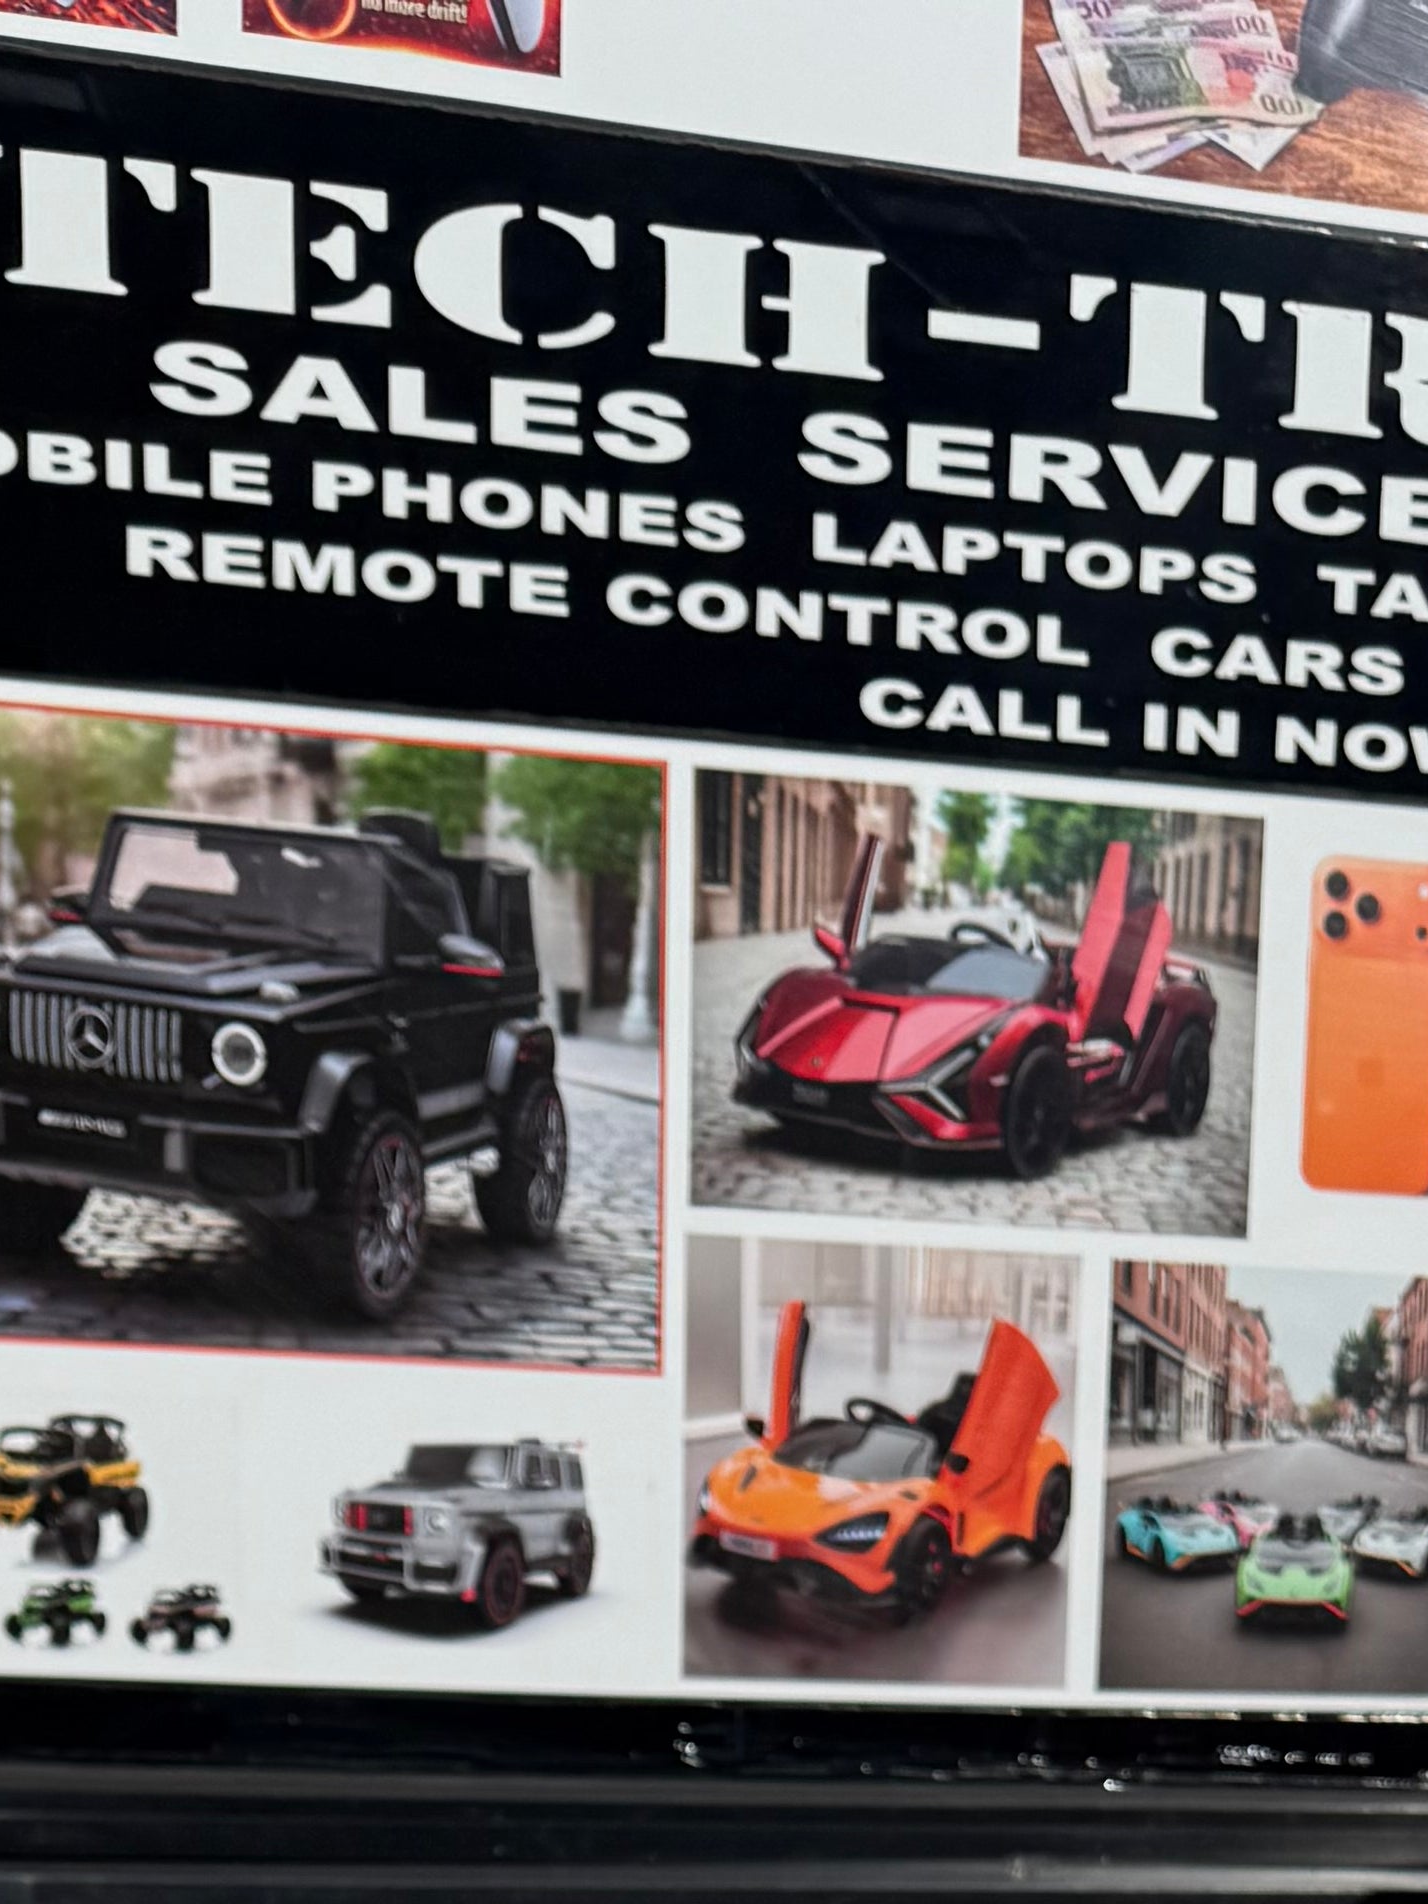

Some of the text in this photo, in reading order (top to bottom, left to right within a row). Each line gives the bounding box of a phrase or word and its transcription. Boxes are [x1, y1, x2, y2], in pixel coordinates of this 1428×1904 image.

[148, 340, 692, 464] SALES
[311, 460, 746, 553] PHONES
[812, 511, 1258, 604] LAPTOPS
[125, 524, 571, 618] REMOTE
[605, 573, 1091, 668] CONTROL
[1150, 626, 1405, 696] CARS
[858, 677, 1111, 748] CALL
[1143, 702, 1241, 758] IN
